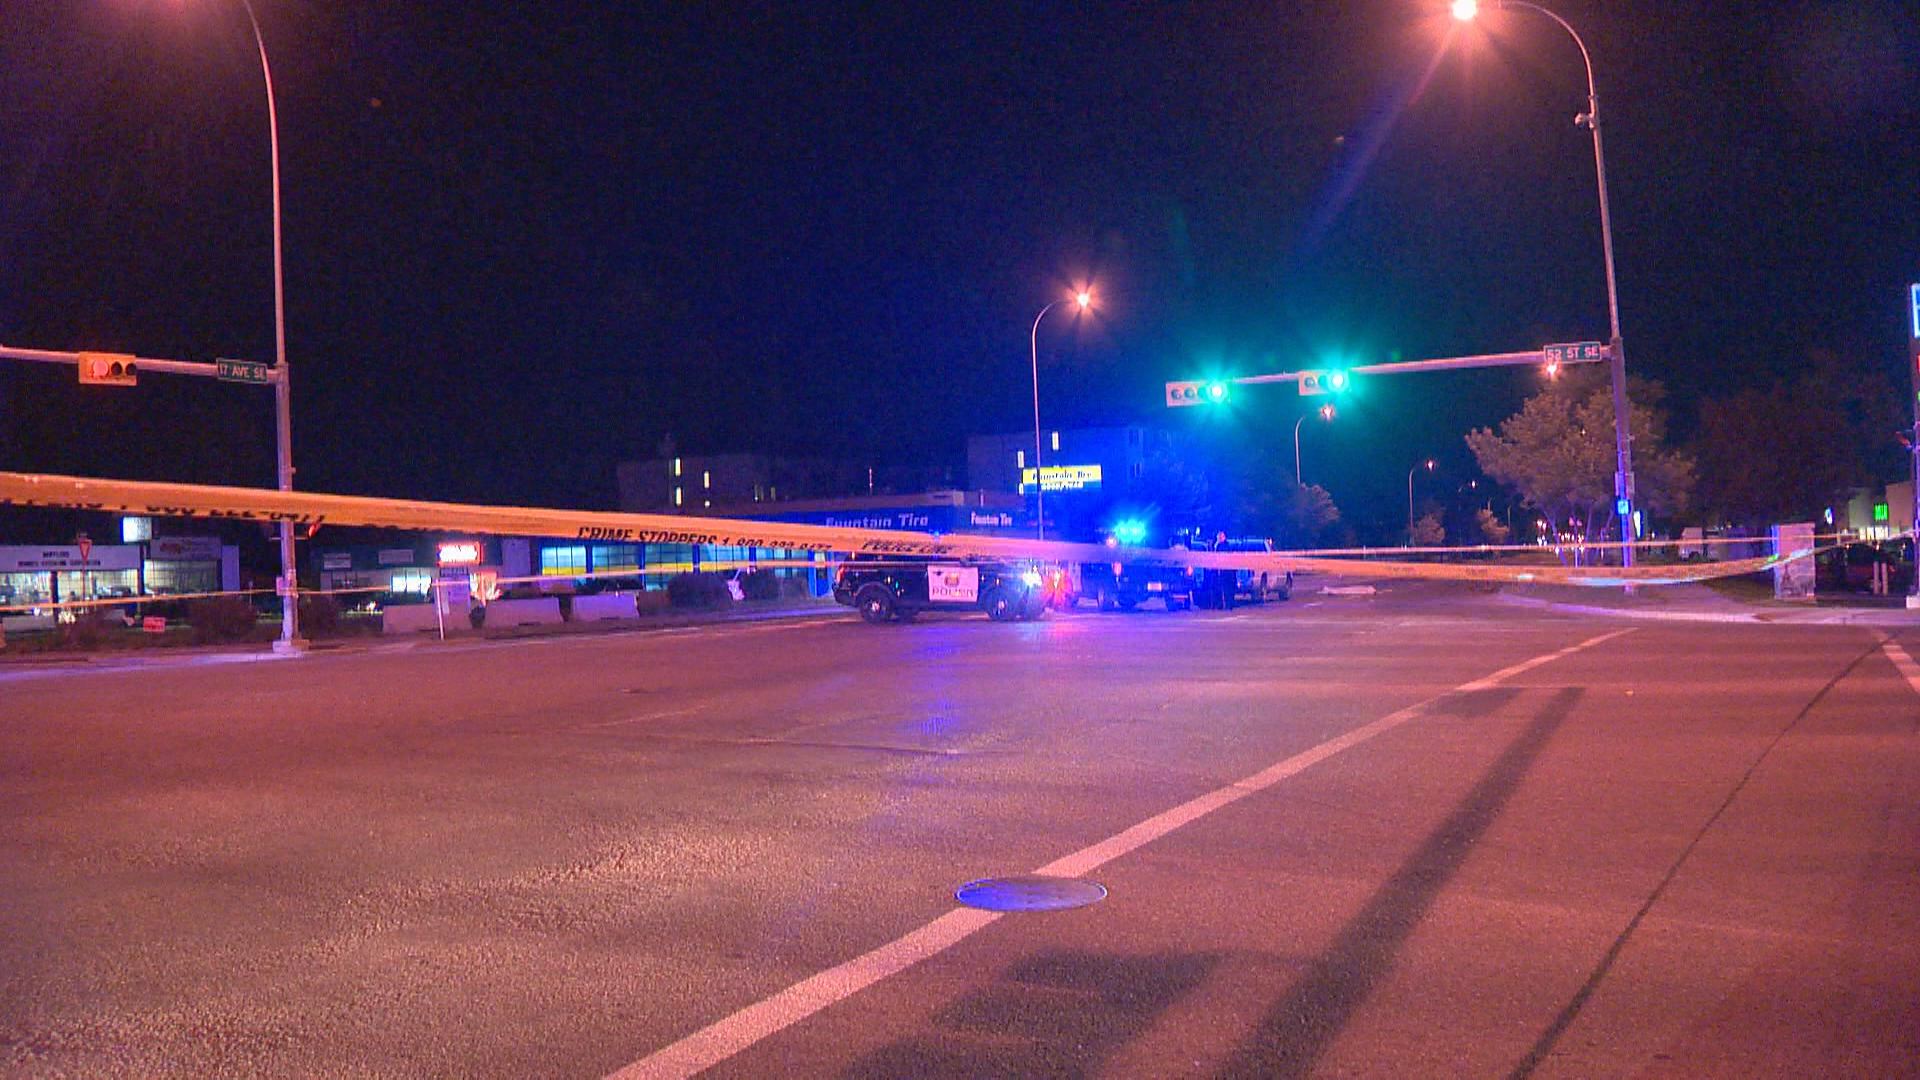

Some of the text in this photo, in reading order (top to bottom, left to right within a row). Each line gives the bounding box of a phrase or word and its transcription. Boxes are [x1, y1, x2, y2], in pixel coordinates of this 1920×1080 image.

[1567, 347, 1580, 358] ST
[1584, 345, 1599, 358] SE
[232, 365, 250, 378] AVE
[253, 367, 265, 379] SE
[578, 526, 633, 540] CRIME
